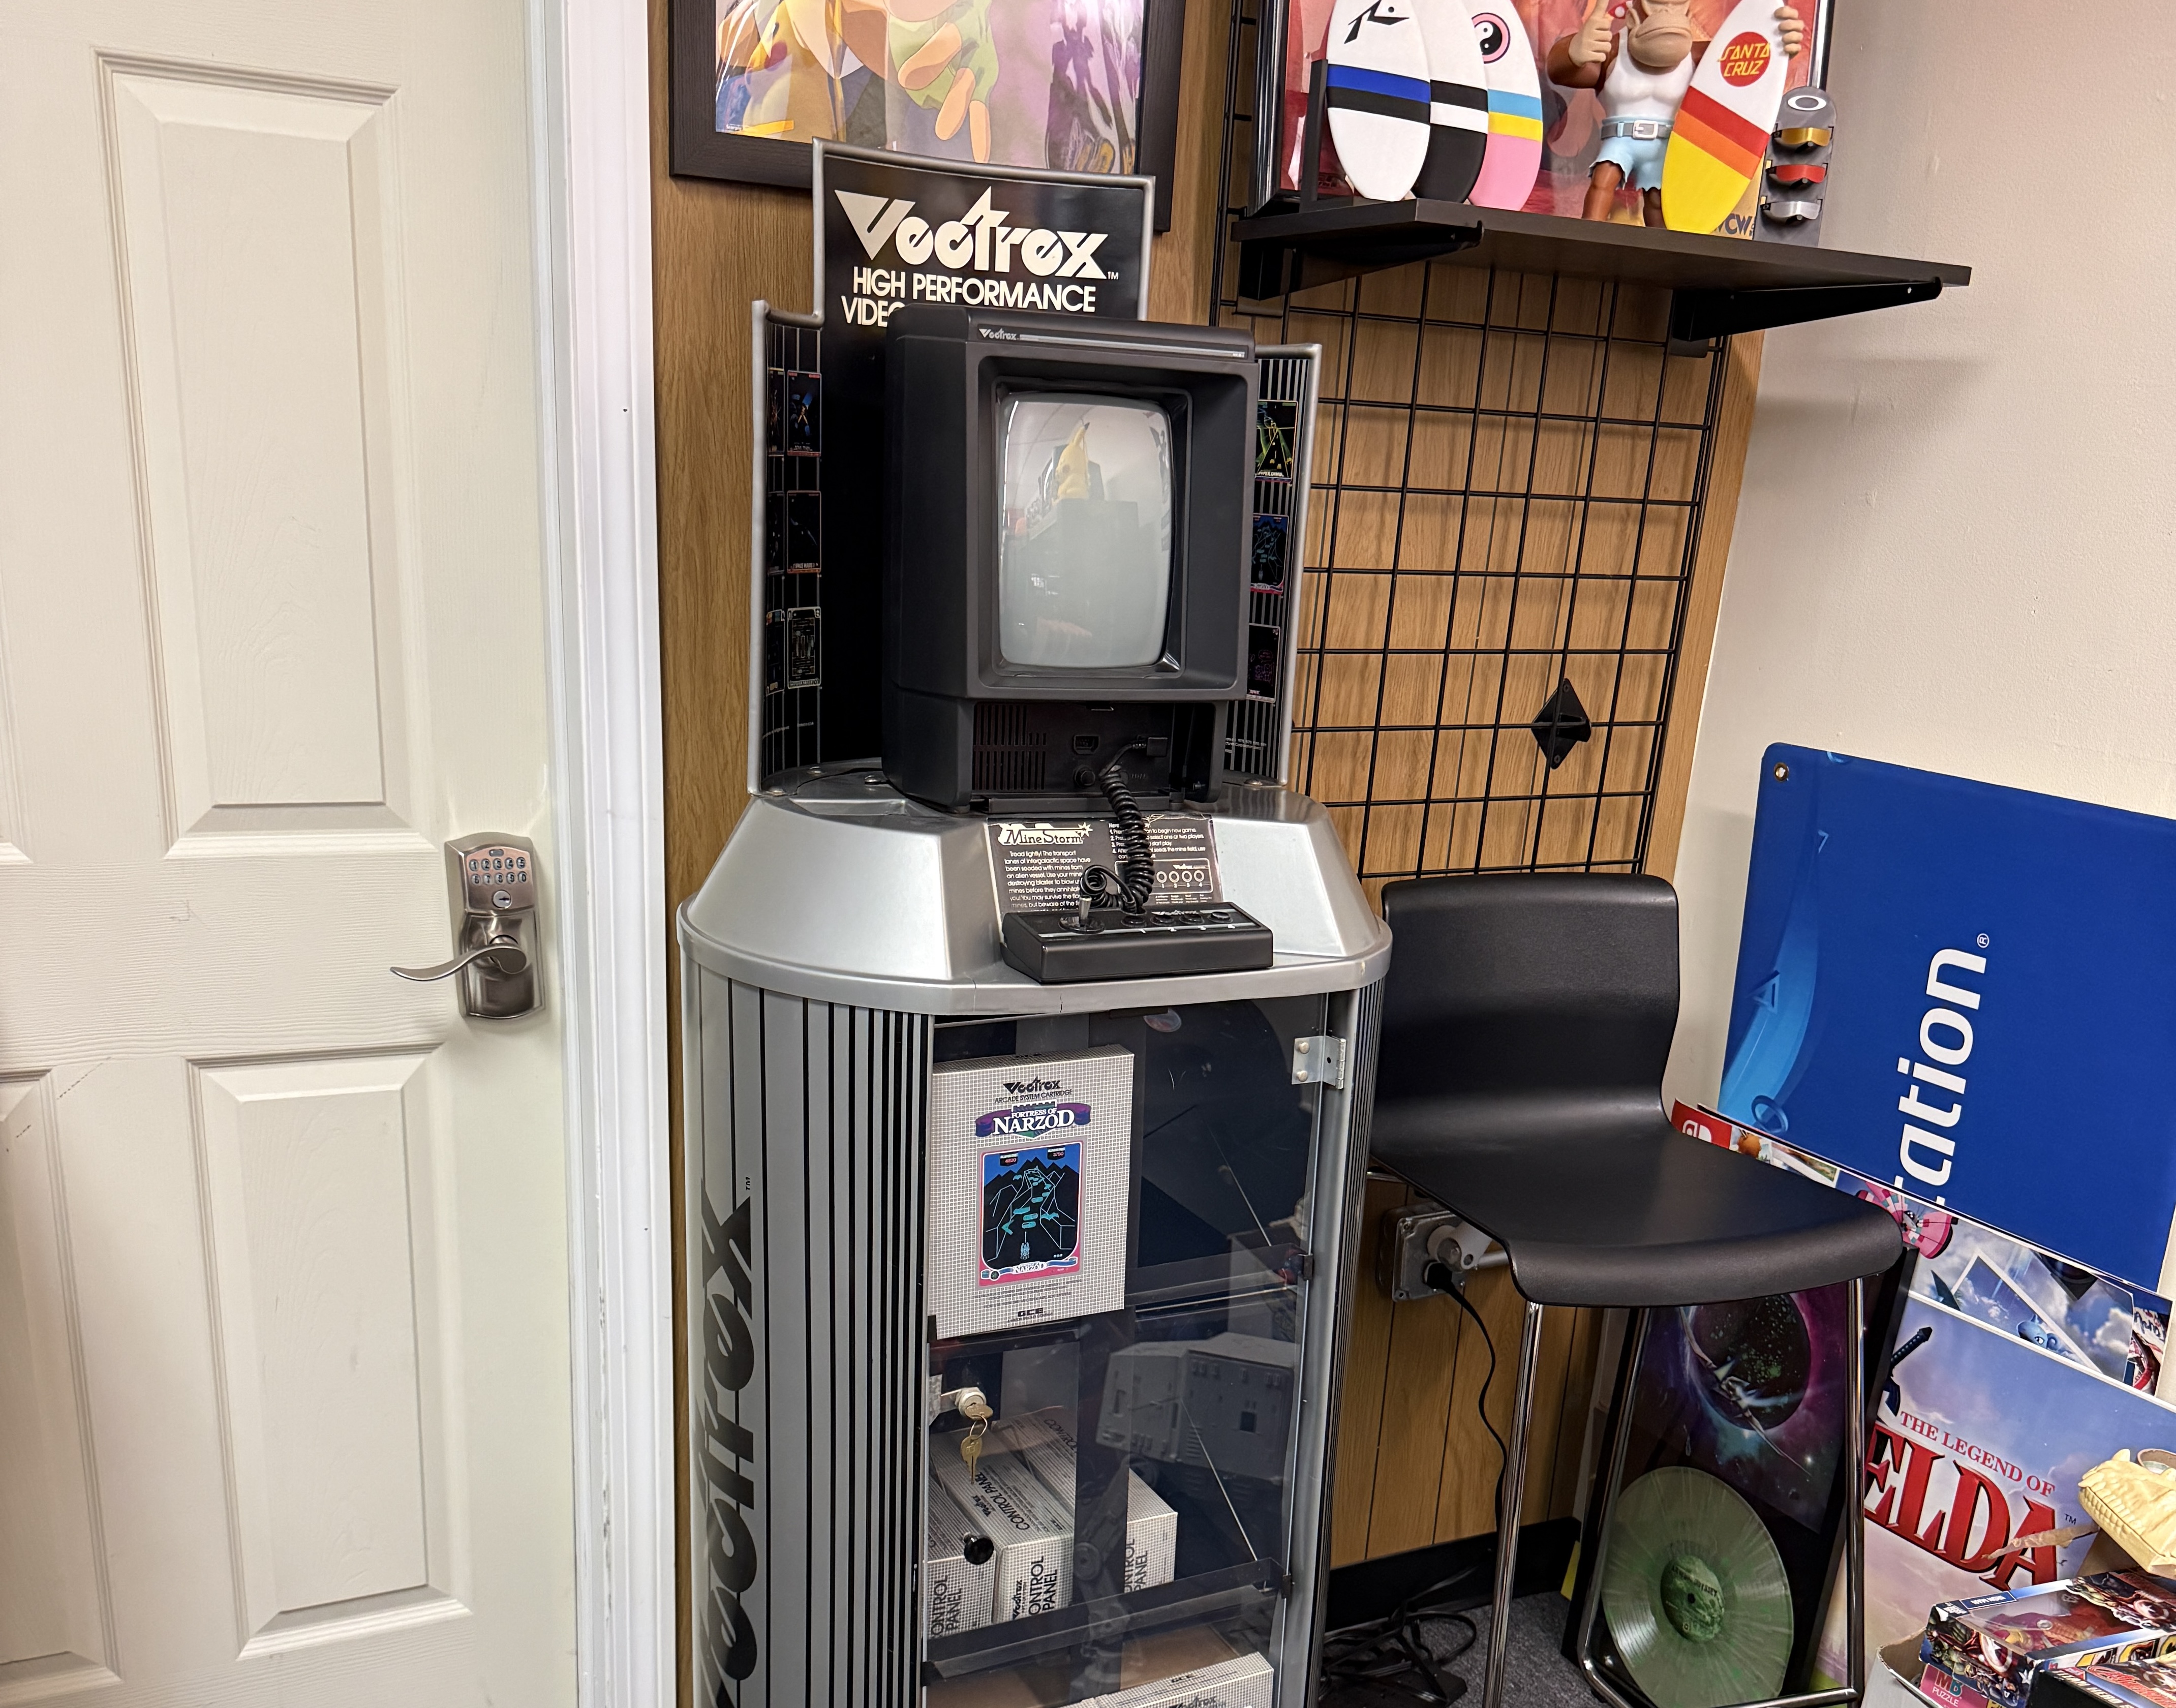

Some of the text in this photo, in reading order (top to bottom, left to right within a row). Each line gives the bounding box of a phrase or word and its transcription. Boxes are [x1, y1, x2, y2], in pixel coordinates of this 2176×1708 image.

[1717, 43, 1770, 62] SANTA
[1723, 60, 1764, 76] CRUZ
[835, 186, 1108, 279] Vectrex
[1718, 213, 1753, 235] CW
[853, 266, 1096, 312] HIGH PERFORMANCE
[841, 295, 905, 327] VIDE
[979, 328, 1017, 341] Vectrex
[1003, 1076, 1061, 1094] Vectrex
[1894, 949, 1986, 1206] ation
[995, 1089, 1072, 1104] ARCADE SYSTEM CARTRIDGE
[993, 1109, 1075, 1135] NARZOD
[1011, 1107, 1058, 1119] FORTRESS OF
[1017, 1307, 1044, 1317] GCE
[1901, 1411, 2055, 1497] THE LEGEND OF
[990, 1493, 1030, 1530] CONTROL
[1864, 1422, 2058, 1592] ELDA
[1028, 1556, 1044, 1615] ONTROL
[1043, 1569, 1058, 1611] PANEL
[931, 1575, 947, 1635] ONTROL
[946, 1588, 962, 1630] PANEL
[1933, 1686, 1959, 1707] PUZZLE
[1935, 1670, 1965, 1697] MB
[2086, 1687, 2123, 1703] HERO
